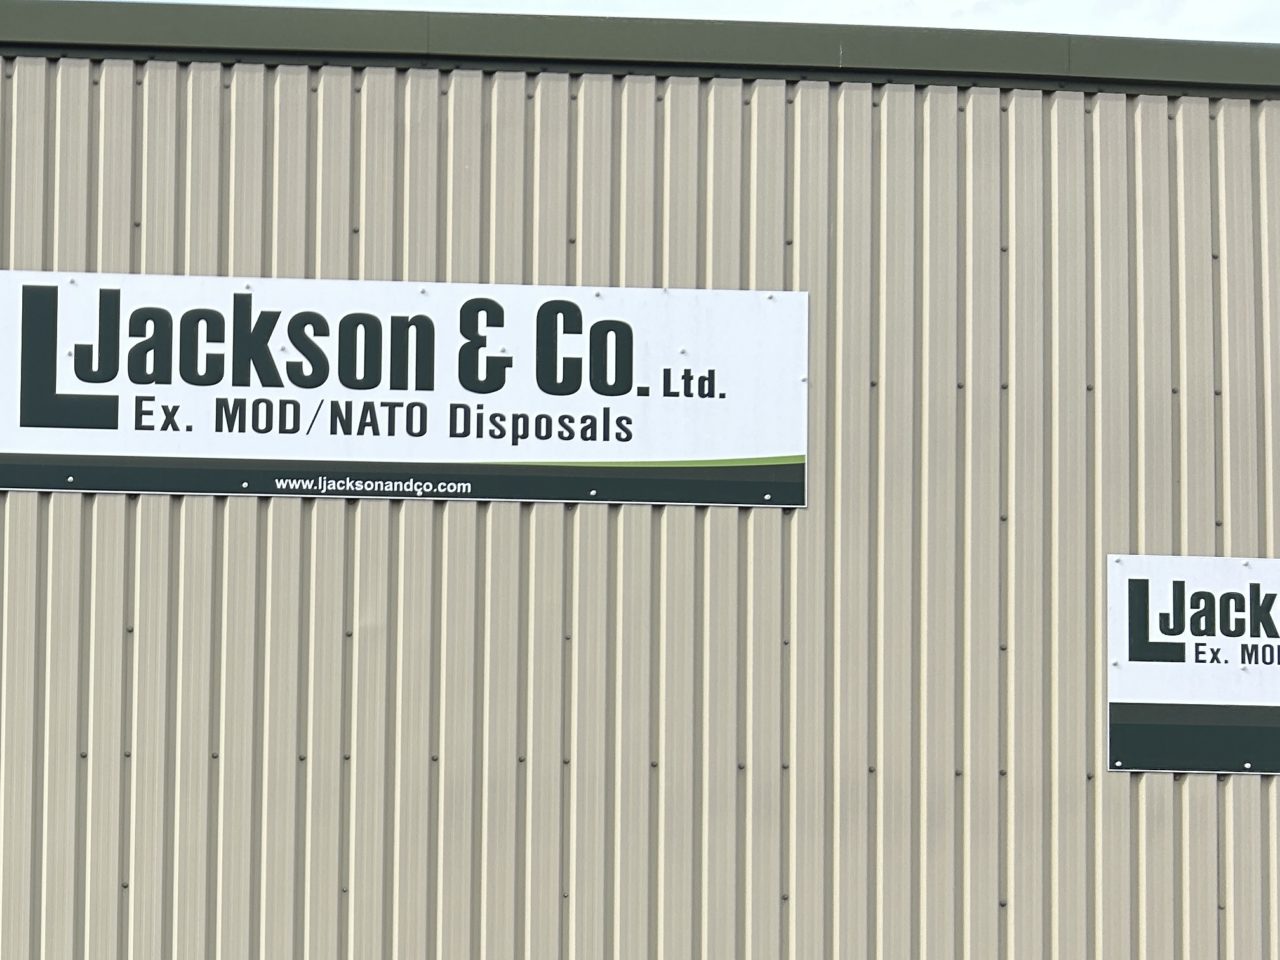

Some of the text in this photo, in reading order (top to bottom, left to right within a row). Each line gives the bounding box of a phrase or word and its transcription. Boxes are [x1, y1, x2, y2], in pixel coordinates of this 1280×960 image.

[457, 297, 514, 395] &
[535, 299, 650, 398] Co.
[662, 368, 726, 399] Ltd.
[134, 395, 194, 433] Ex.
[449, 403, 634, 446] Disposals
[274, 477, 472, 495] www.ljacksonandco.com
[1194, 642, 1280, 666] Ex. MO
